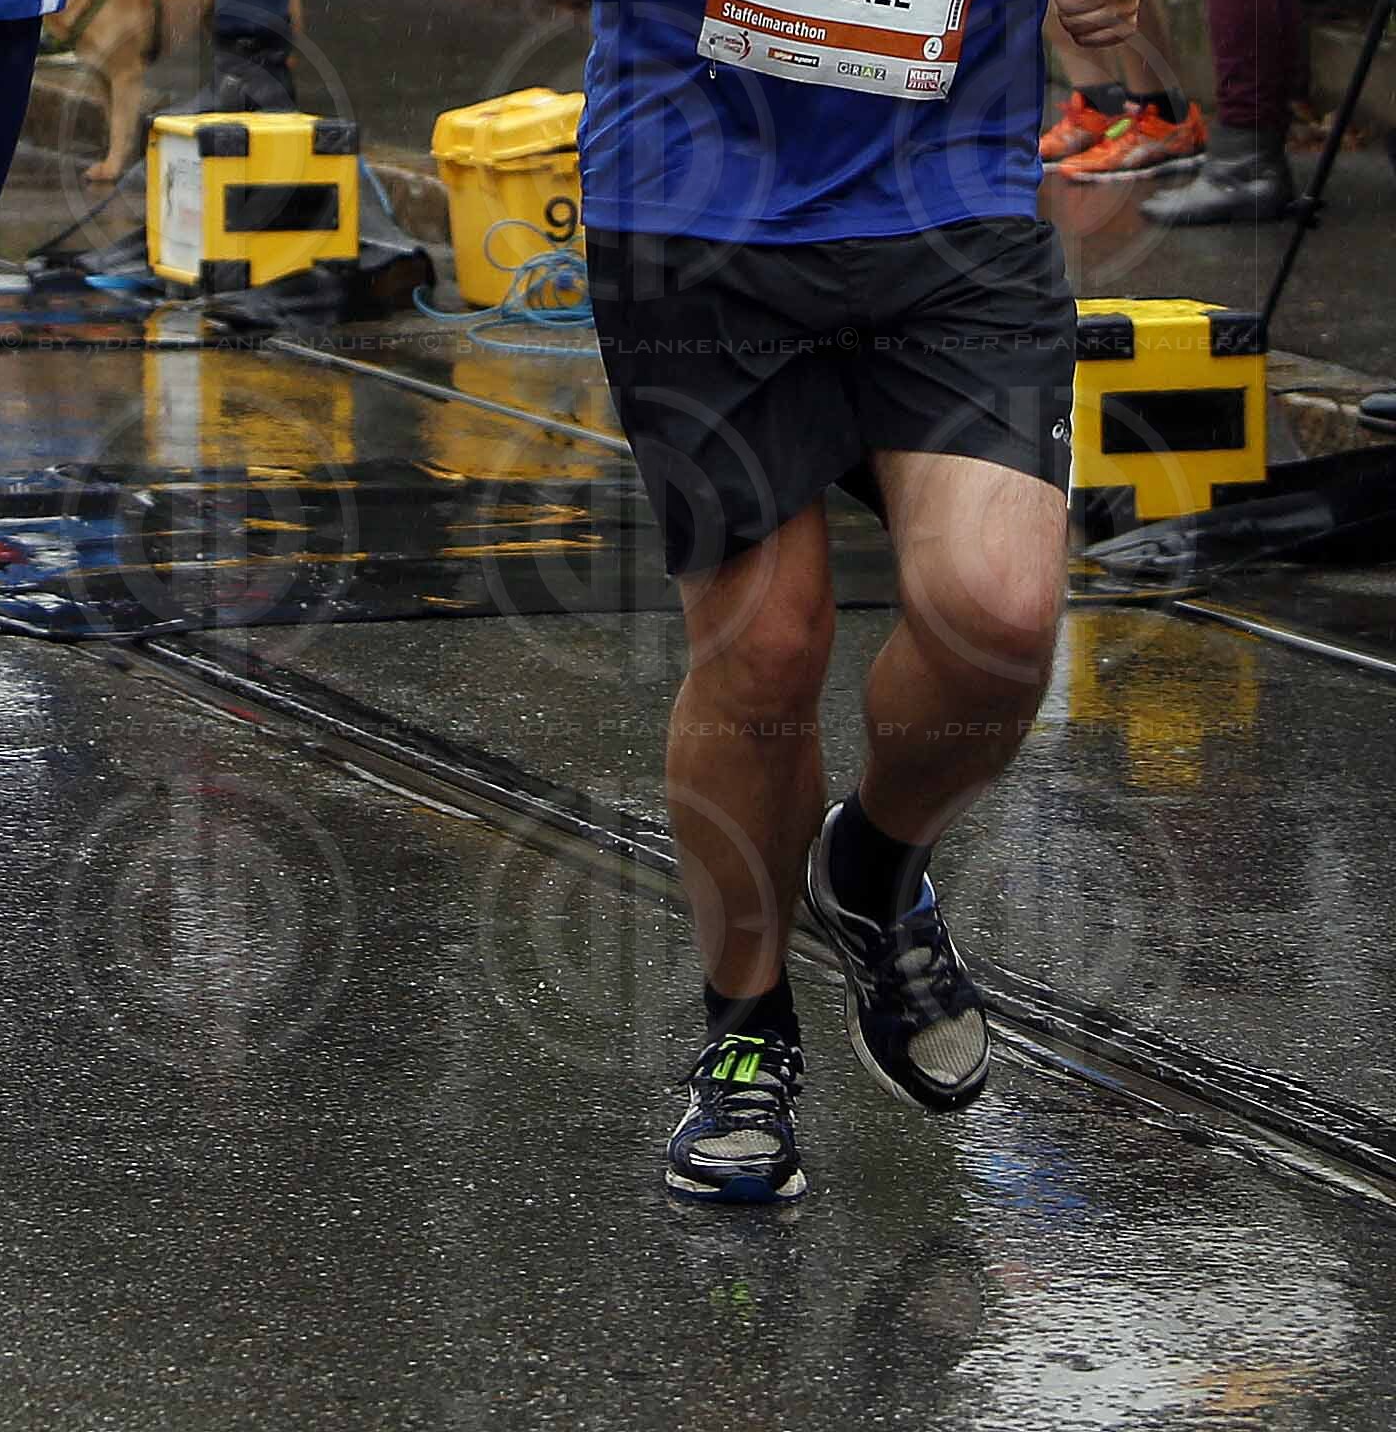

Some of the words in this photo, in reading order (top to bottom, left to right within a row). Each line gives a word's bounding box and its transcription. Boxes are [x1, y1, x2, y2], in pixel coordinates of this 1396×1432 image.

[722, 2, 827, 40] Staffelmarathon
[837, 62, 887, 81] GRAZ
[544, 196, 577, 242] 9
